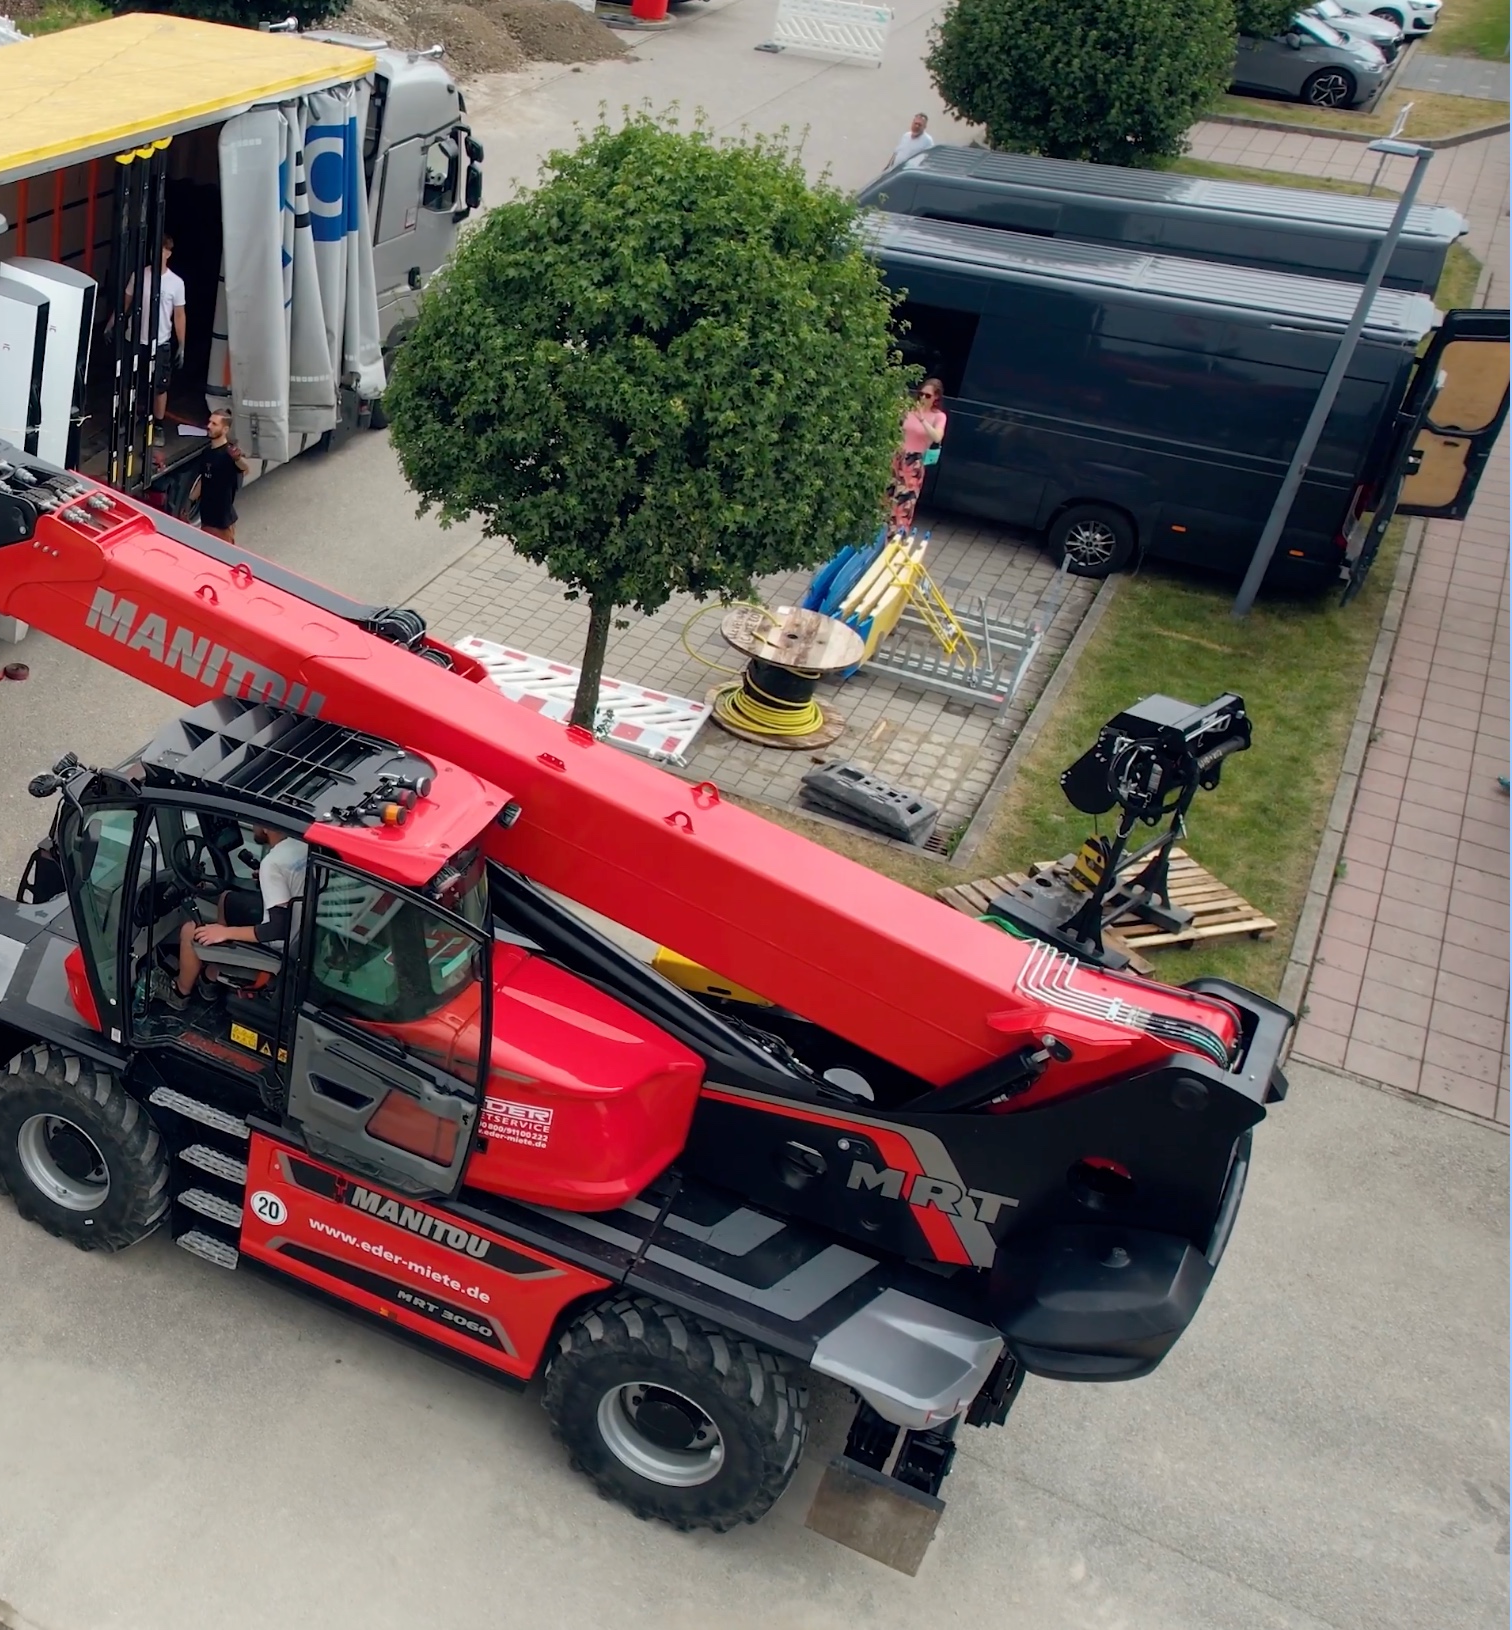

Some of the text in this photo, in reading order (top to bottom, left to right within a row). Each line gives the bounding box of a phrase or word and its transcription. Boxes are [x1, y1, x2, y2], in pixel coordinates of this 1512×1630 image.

[484, 1098, 550, 1122] DER
[258, 1196, 279, 1220] 20
[846, 1159, 1020, 1224] MRT
[350, 1185, 491, 1259] MANITOU
[309, 1217, 491, 1304] www.eder-miete.de
[397, 1290, 494, 1338] MRT 3060
